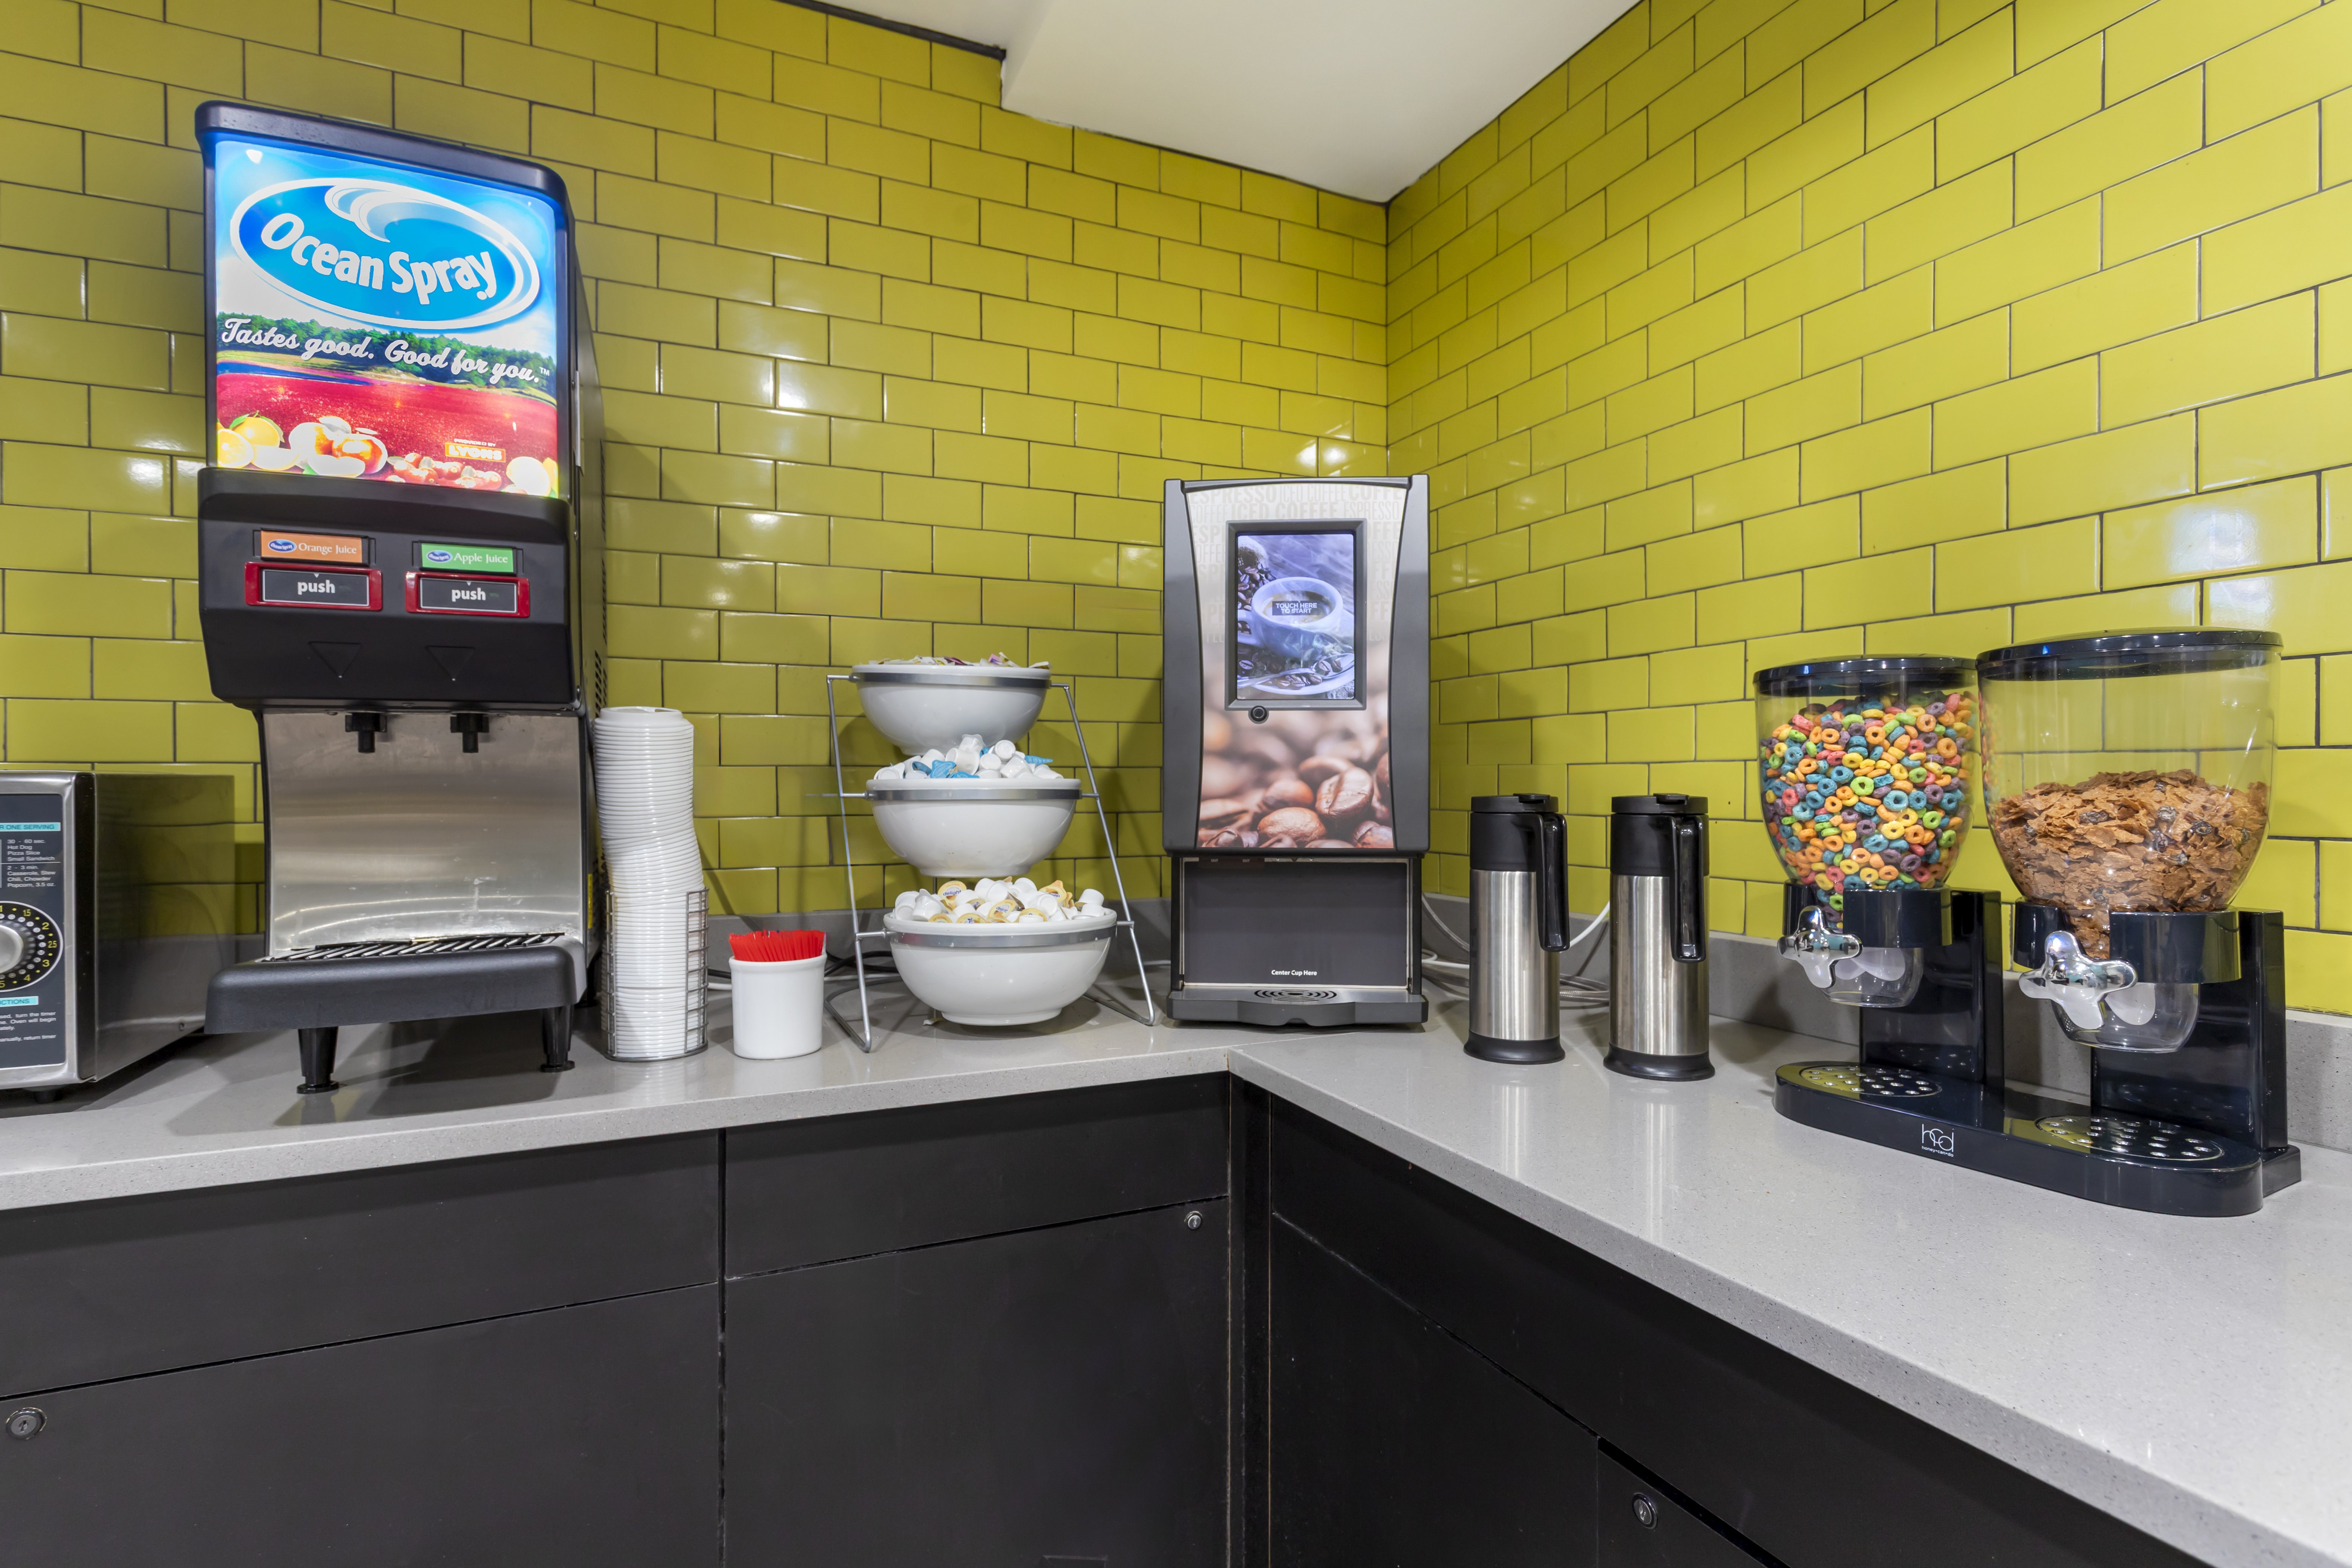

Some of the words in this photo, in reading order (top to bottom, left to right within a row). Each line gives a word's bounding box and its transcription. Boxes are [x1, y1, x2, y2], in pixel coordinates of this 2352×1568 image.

[261, 213, 384, 289] Ocean
[389, 251, 497, 304] Spray
[222, 318, 300, 349] Tastes
[301, 337, 374, 360] good.
[385, 340, 451, 368] Good
[452, 349, 488, 375] for
[449, 445, 502, 460] LYONS
[299, 543, 332, 555] Orange
[336, 545, 357, 554] Juice
[454, 553, 482, 564] Apple
[486, 554, 508, 564] Juice
[298, 580, 335, 595] push
[452, 588, 486, 602] push
